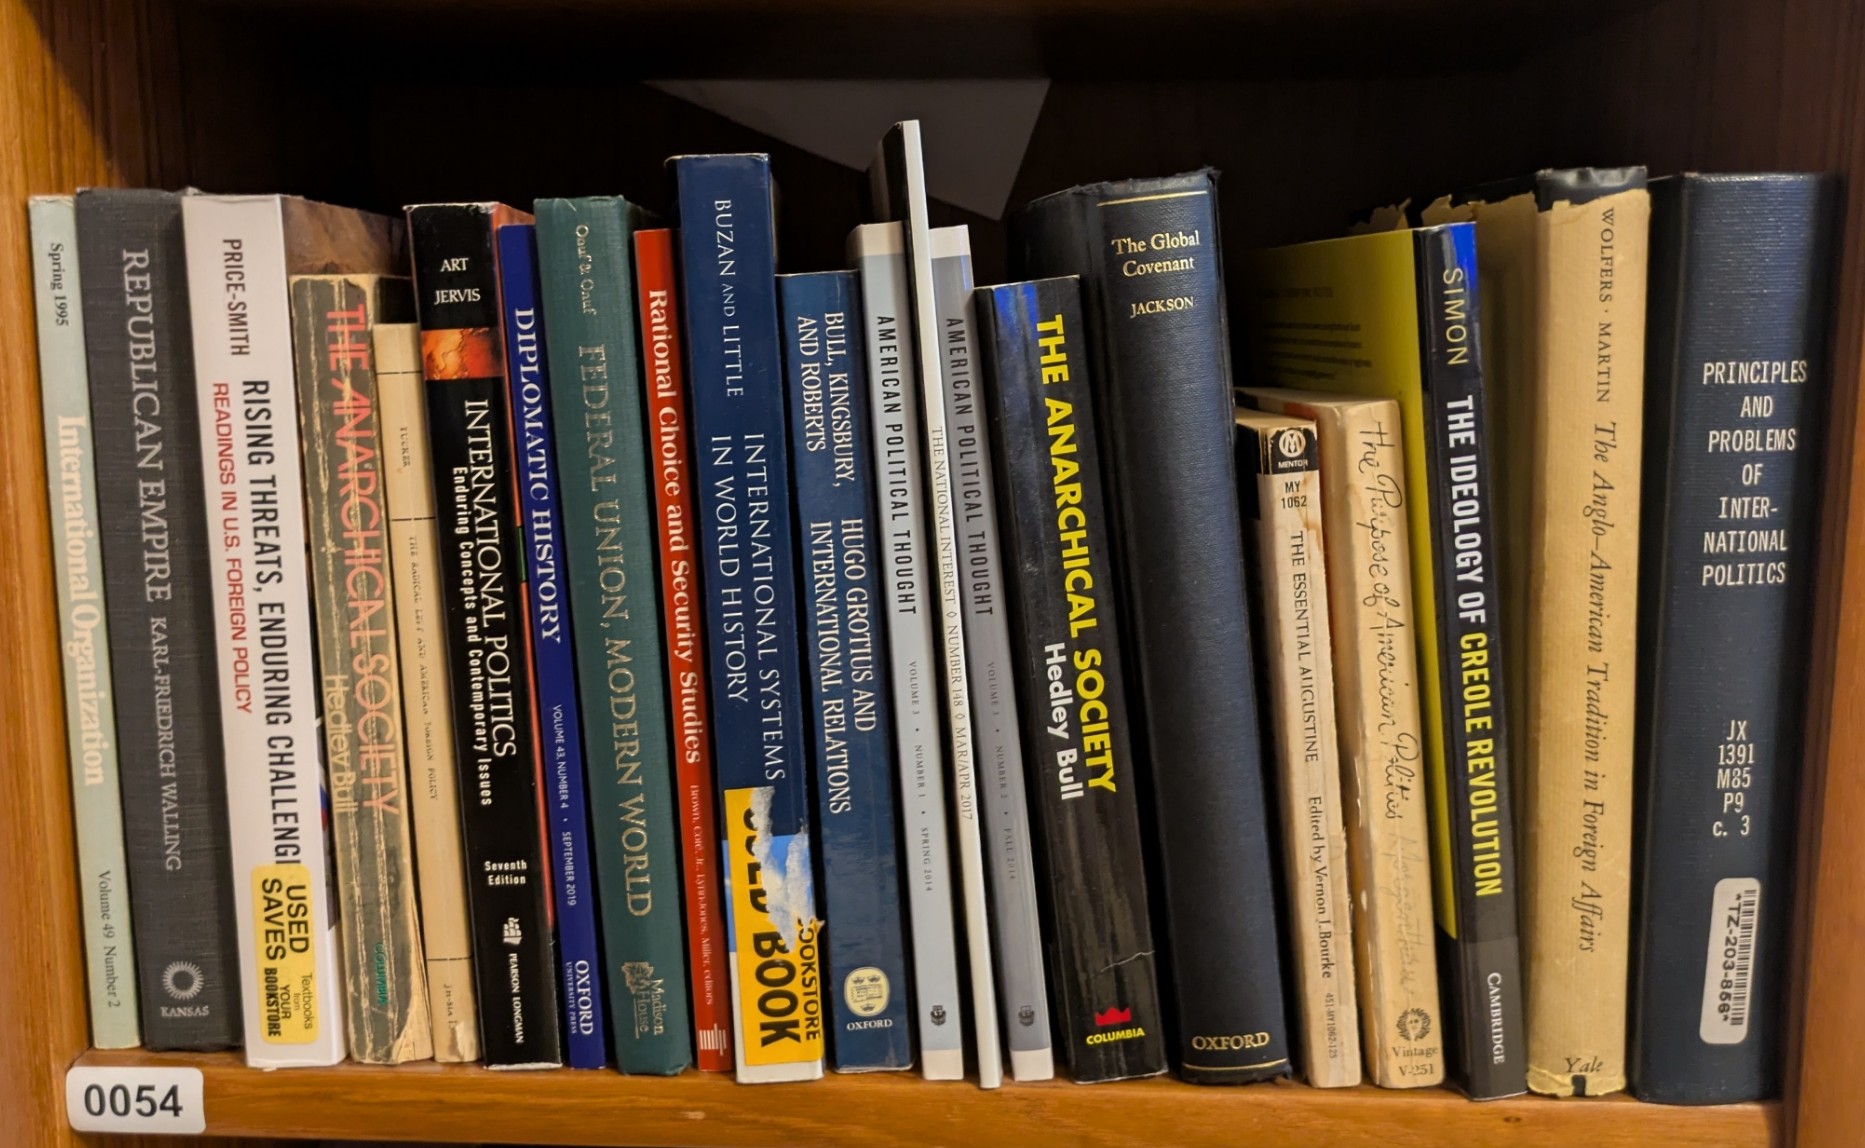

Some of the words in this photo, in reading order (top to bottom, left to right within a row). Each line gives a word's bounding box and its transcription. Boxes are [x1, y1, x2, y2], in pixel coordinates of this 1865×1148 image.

[48, 241, 65, 291] Spring
[440, 257, 469, 272] ART
[575, 224, 592, 262] Onuf
[715, 199, 737, 277] BUZAN
[1111, 237, 1147, 256] The
[1150, 231, 1200, 251] Global
[1122, 256, 1195, 277] Covenant
[1600, 207, 1615, 303] WOLFERS
[53, 293, 69, 326] 1995
[223, 238, 250, 356] PRICE-SMITH
[434, 288, 481, 305] JERVIS
[581, 280, 596, 315] Onuf
[722, 284, 736, 318] AND
[1130, 296, 1195, 318] JACKSON
[1443, 268, 1469, 365] SIMON
[123, 249, 163, 470] REPUBLICAN
[326, 305, 369, 371] THE
[648, 290, 678, 400] Rational
[722, 325, 744, 397] LITTLE
[797, 316, 819, 356] AND
[824, 312, 845, 370] BULL,
[877, 315, 901, 414] AMERICAN
[946, 317, 972, 415] AMERICAN
[1036, 314, 1071, 385] THE
[1598, 322, 1613, 403] MARTIN
[1703, 361, 1808, 384] PRINCIPLES
[213, 383, 235, 485] READINGS
[242, 380, 275, 465] RISING
[578, 344, 617, 493] FEDERAL
[801, 363, 826, 453] ROBERTS
[828, 374, 855, 487] KINGSBURY,
[1447, 395, 1475, 449] THE
[1740, 396, 1774, 417] AND
[400, 426, 411, 468] TUCKER
[658, 407, 681, 497] Choice
[711, 437, 733, 466] IN
[931, 426, 944, 458] THE
[1278, 459, 1308, 469] MENTOR
[1358, 421, 1395, 474] The
[1594, 422, 1617, 461] The
[1708, 429, 1796, 452] PROBLEMS
[219, 493, 238, 511] IN
[452, 467, 469, 534] Enduring
[516, 307, 548, 502] DIPLOMATIC
[532, 508, 561, 644] HISTORY
[885, 423, 909, 521] POLITICAL
[934, 463, 950, 534] NATIONAL
[957, 426, 983, 523] POLITICAL
[1281, 495, 1307, 509] 1062
[1285, 481, 1301, 493] MY
[1742, 464, 1763, 486] OF
[57, 415, 94, 602] International
[223, 517, 241, 552] U.S.
[249, 475, 284, 592] THREATS,
[332, 377, 387, 648] ANARCHICAL
[666, 504, 685, 553] and
[714, 475, 741, 578] WORLD
[1044, 396, 1097, 638] ANARCHICAL
[1449, 455, 1484, 584] IDEOLOGY
[1718, 497, 1778, 519] INTER-
[139, 480, 172, 602] EMPIRE
[593, 498, 628, 627] UNION,
[745, 432, 778, 660] INTERNATIONAL
[840, 518, 865, 580] HUGO
[941, 537, 956, 604] INTEREST
[1290, 531, 1305, 567] THE
[1704, 531, 1788, 553] NATIONAL
[226, 557, 248, 640] FOREIGN
[460, 540, 476, 609] Concepts
[465, 399, 501, 630] INTERNATIONAL
[485, 636, 517, 757] POLITICS
[893, 530, 917, 615] THOUGHT
[967, 531, 993, 616] THOUGHT
[1362, 582, 1401, 608] of
[1702, 563, 1786, 586] POLITICS
[465, 618, 477, 643] and
[670, 559, 694, 664] Security
[810, 521, 843, 693] INTERNATIONAL
[845, 586, 874, 682] GROTIUS
[1293, 572, 1308, 661] ESSENTIAL
[1459, 588, 1486, 623] OF
[258, 602, 292, 724] ENDURING
[721, 586, 748, 703] HISTORY
[947, 624, 962, 682] NUMBER
[1369, 611, 1408, 734] American
[67, 602, 104, 786] Organization
[150, 616, 177, 777] KARL-FRIEDRICH
[231, 647, 252, 714] POLICY
[468, 647, 487, 752] Contemporary
[852, 689, 876, 732] AND
[953, 686, 964, 707] 148
[1044, 642, 1073, 740] Hedley
[1461, 633, 1490, 731] CREOLE
[325, 674, 353, 770] Hedley
[353, 652, 399, 815] SOCIETY
[552, 704, 566, 749] VOLUME
[605, 638, 643, 786] MODERN
[679, 671, 702, 764] Studies
[760, 670, 785, 781] SYSTEMS
[1074, 648, 1117, 793] SOCIETY
[1300, 667, 1319, 763] AUGUSTINE
[1585, 663, 1608, 763] Tradition
[1726, 720, 1747, 740] JX
[480, 758, 492, 806] Issues
[557, 763, 569, 797] NUMBER
[822, 700, 852, 815] RELATIONS
[955, 727, 971, 790] MAR/APR
[1056, 748, 1084, 800] Bull
[1380, 731, 1419, 820] Politics
[1584, 769, 1600, 791] in
[1716, 768, 1751, 788] M85
[1718, 744, 1755, 765] 1391
[156, 781, 182, 872] WALLING
[961, 794, 974, 821] 2017
[1308, 796, 1324, 841] Edited
[1467, 738, 1502, 898] REVOLUTION
[1712, 820, 1728, 837] c.
[1740, 816, 1750, 837] 3
[1724, 793, 1744, 814] P9
[561, 831, 576, 882] SEPTEMBER
[619, 793, 652, 917] WORLD
[921, 827, 931, 866] SPRING
[1310, 845, 1325, 863] by
[1574, 799, 1604, 872] Foreign
[98, 870, 115, 917] Volume
[485, 860, 527, 872] Seventh
[488, 874, 527, 886] Edition
[567, 884, 577, 906] 2019
[1314, 866, 1327, 915] Vernon
[103, 920, 115, 940] 49
[260, 878, 286, 961] SAVES
[286, 884, 309, 954] USED
[1573, 881, 1603, 953] Affairs
[104, 945, 119, 996] Number
[509, 953, 520, 992] PEARSON
[575, 960, 594, 1035] OXFORD
[754, 933, 803, 1048] BOOK
[160, 1005, 209, 1017] KANSAS
[263, 967, 282, 1037] BOOKSTORE
[280, 984, 292, 1019] YOUR
[300, 972, 313, 1030] Textbooks
[512, 997, 524, 1043] LONGMAN
[636, 991, 651, 1032] House
[650, 978, 668, 1036] Madison
[847, 1018, 893, 1031] OXFORD
[1487, 972, 1505, 1065] CAMBRIDGE
[1086, 1027, 1146, 1045] COLUMBIA
[1191, 1031, 1270, 1051] OXFORD
[1392, 1045, 1439, 1058] Vintage
[1564, 1057, 1603, 1074] Yale
[1399, 1063, 1434, 1076] V-251
[84, 1084, 183, 1118] 0054
